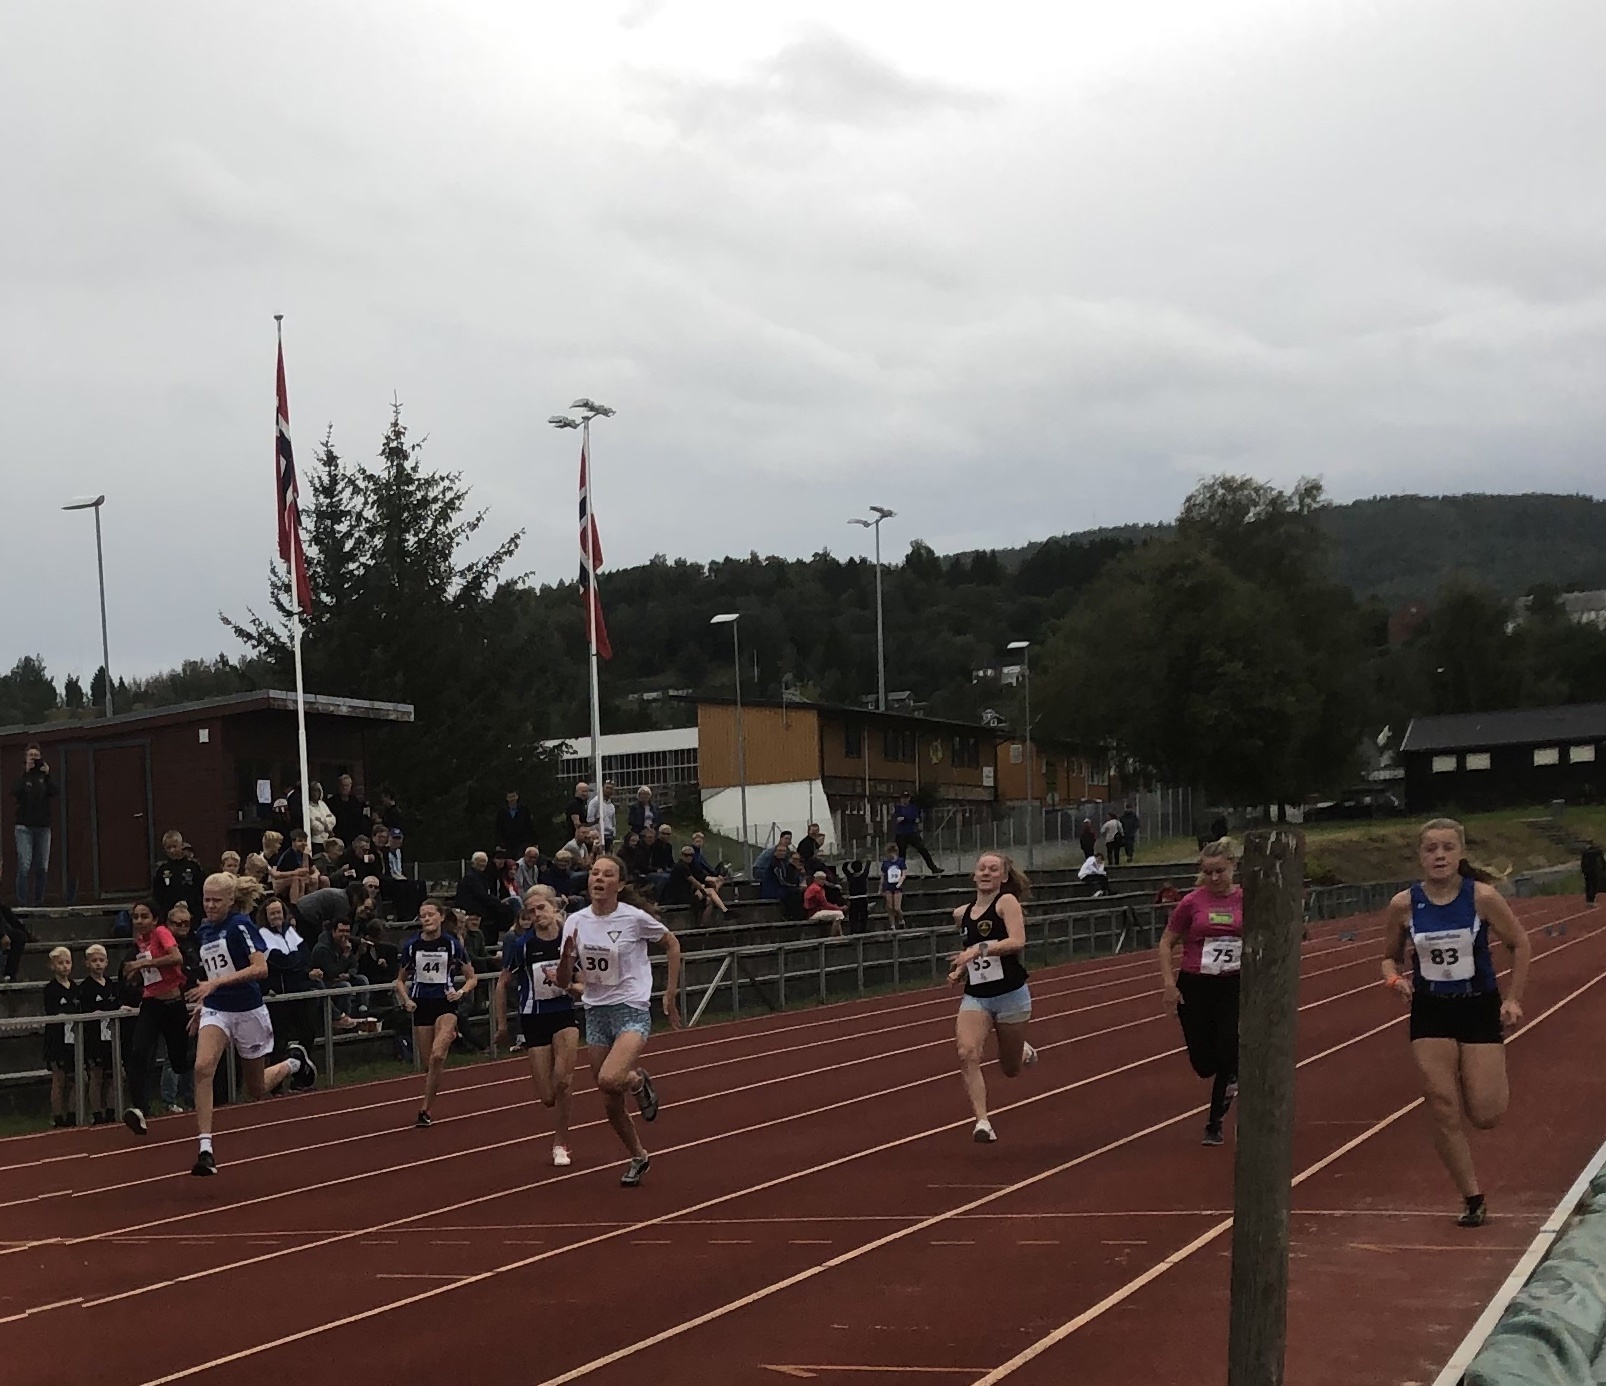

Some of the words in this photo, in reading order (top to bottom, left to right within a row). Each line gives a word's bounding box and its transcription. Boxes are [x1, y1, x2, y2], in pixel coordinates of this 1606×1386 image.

[204, 953, 229, 971] 113
[585, 956, 609, 971] 30
[1213, 949, 1234, 963] 75
[1430, 947, 1459, 965] 83
[422, 962, 440, 973] 44
